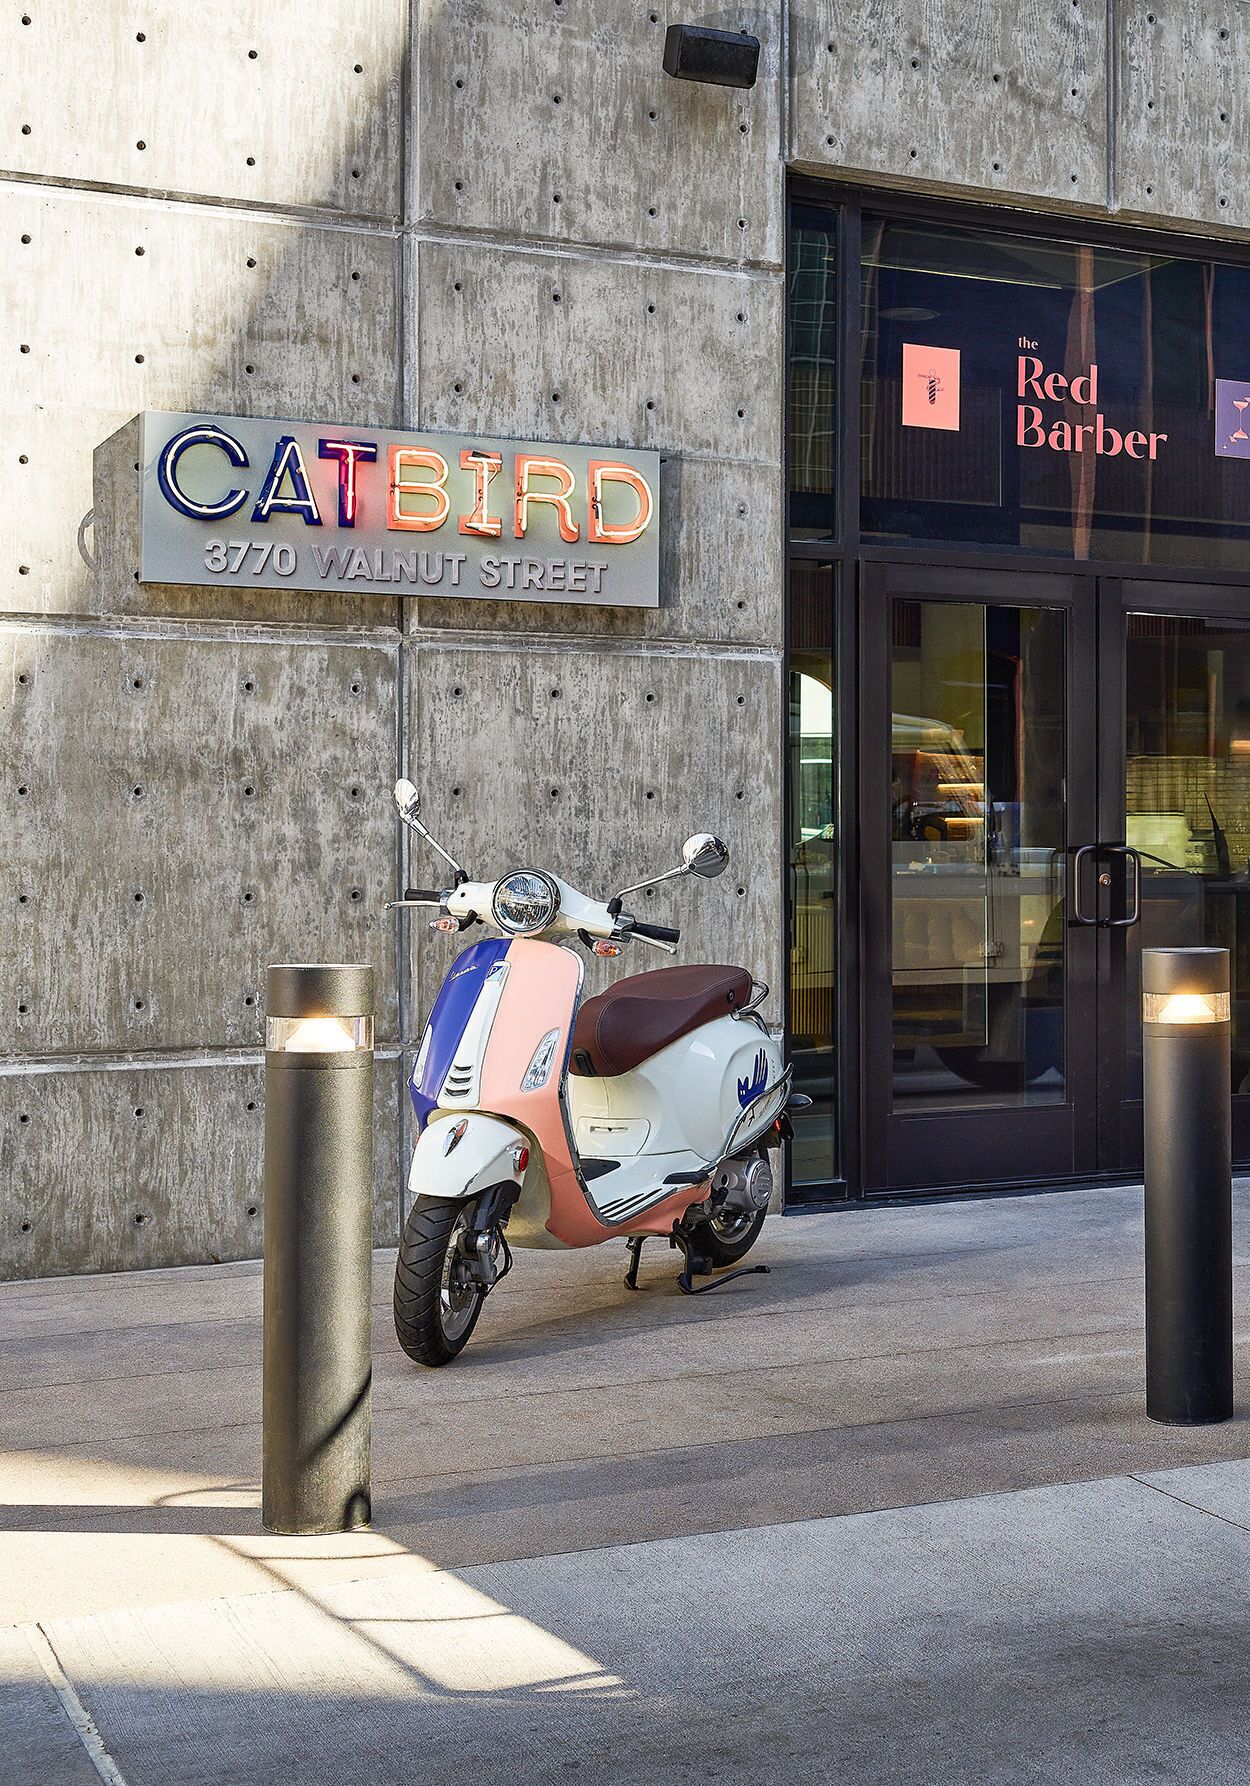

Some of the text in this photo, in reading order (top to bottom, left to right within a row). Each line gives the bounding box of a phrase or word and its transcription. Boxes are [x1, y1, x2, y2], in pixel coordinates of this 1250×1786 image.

[1018, 336, 1039, 350] the
[1017, 355, 1098, 405] Red
[1017, 404, 1168, 460] Barber
[157, 424, 654, 544] CATBIRD
[203, 540, 608, 593] 3770 WALNUT STREET
